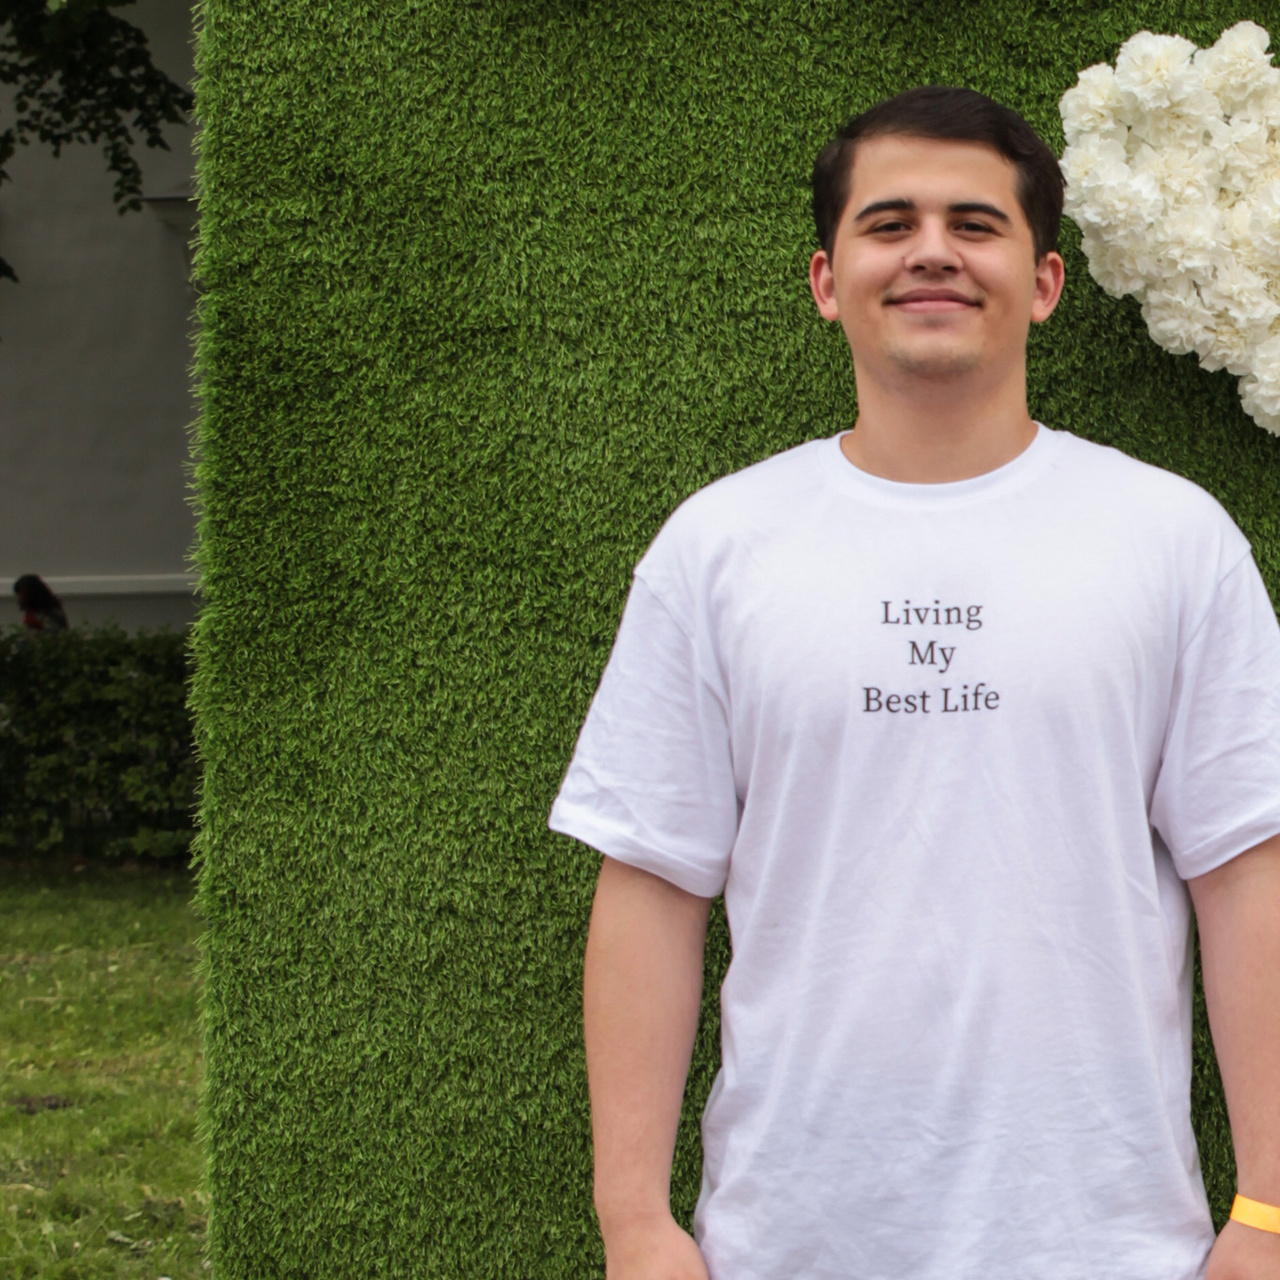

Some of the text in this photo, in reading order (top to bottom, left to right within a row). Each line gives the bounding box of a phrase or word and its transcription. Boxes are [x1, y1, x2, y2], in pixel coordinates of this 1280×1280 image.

[881, 599, 983, 631] Living
[908, 640, 956, 674] My
[862, 682, 1000, 714] Best Life
